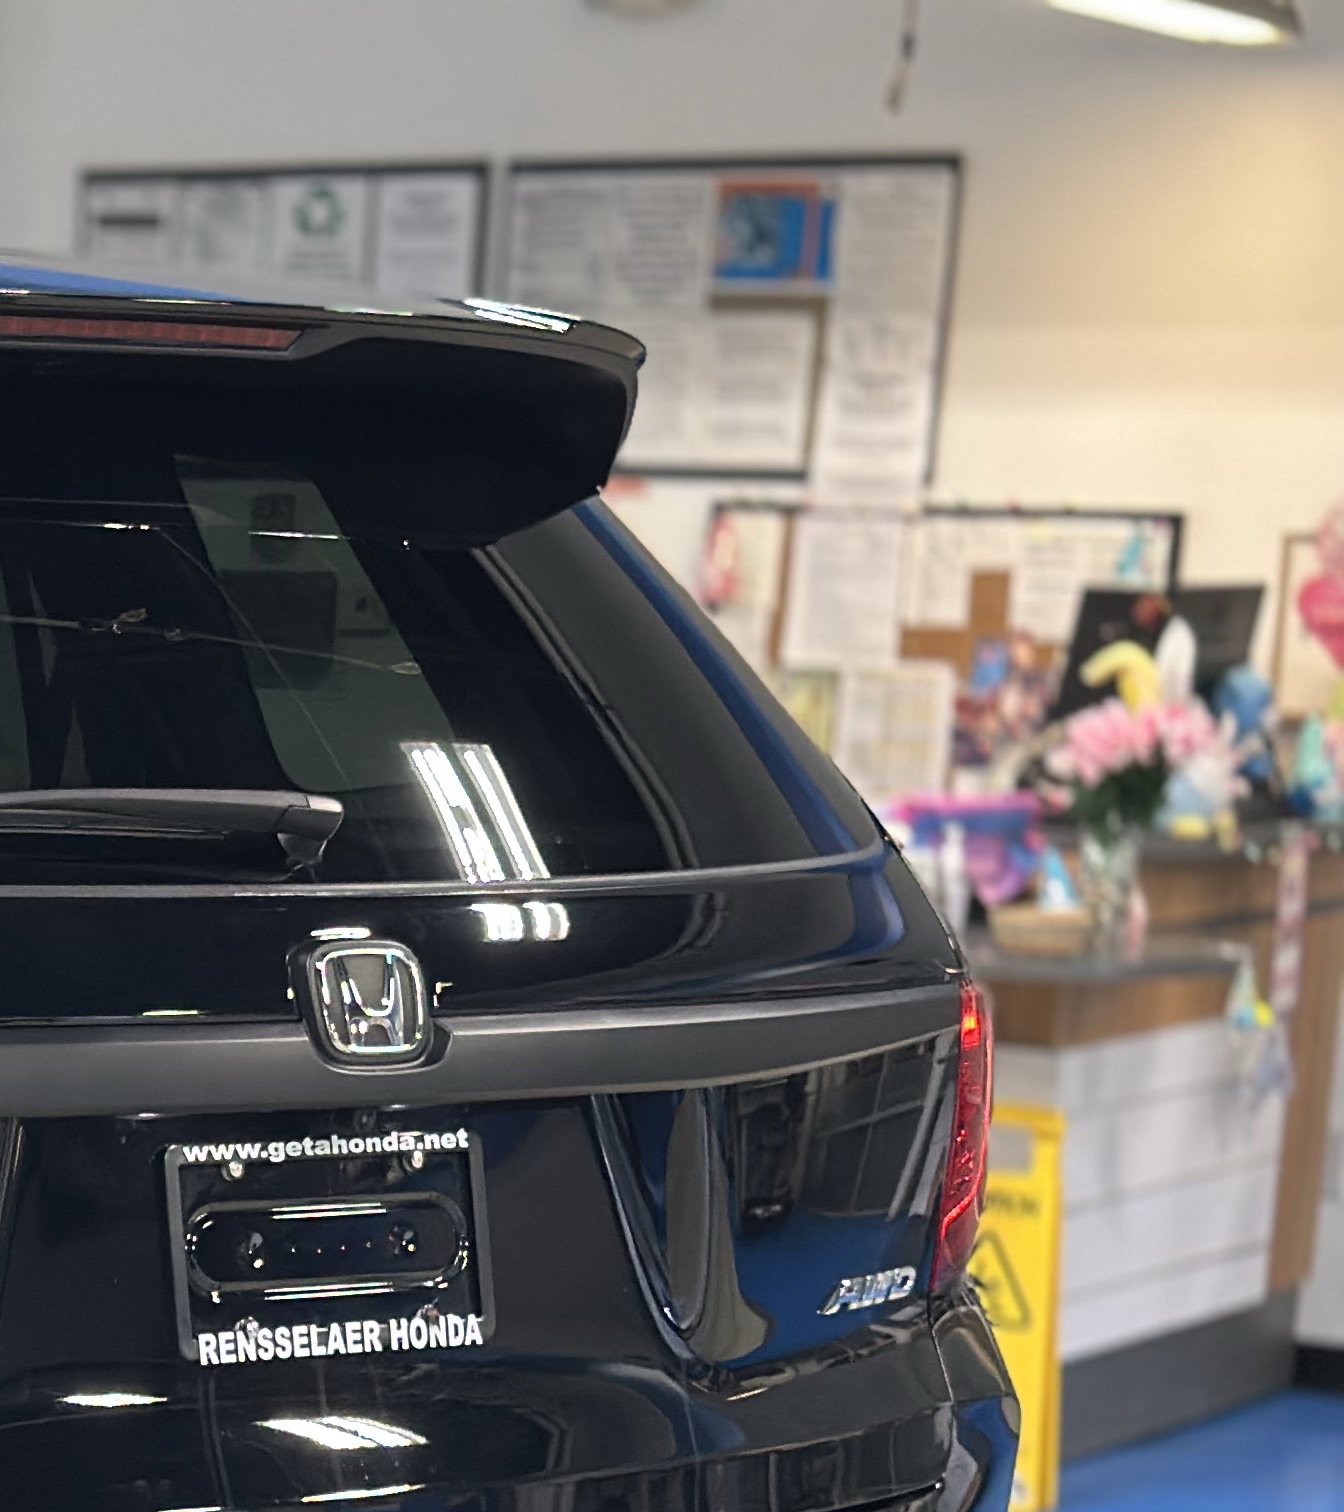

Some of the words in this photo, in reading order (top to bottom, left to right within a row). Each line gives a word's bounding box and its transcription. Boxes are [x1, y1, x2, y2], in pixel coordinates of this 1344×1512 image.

[183, 1127, 470, 1163] www.getahonda.net
[816, 1265, 917, 1316] AWD
[197, 1319, 384, 1366] RENSSELAER
[389, 1313, 484, 1352] HONDA
